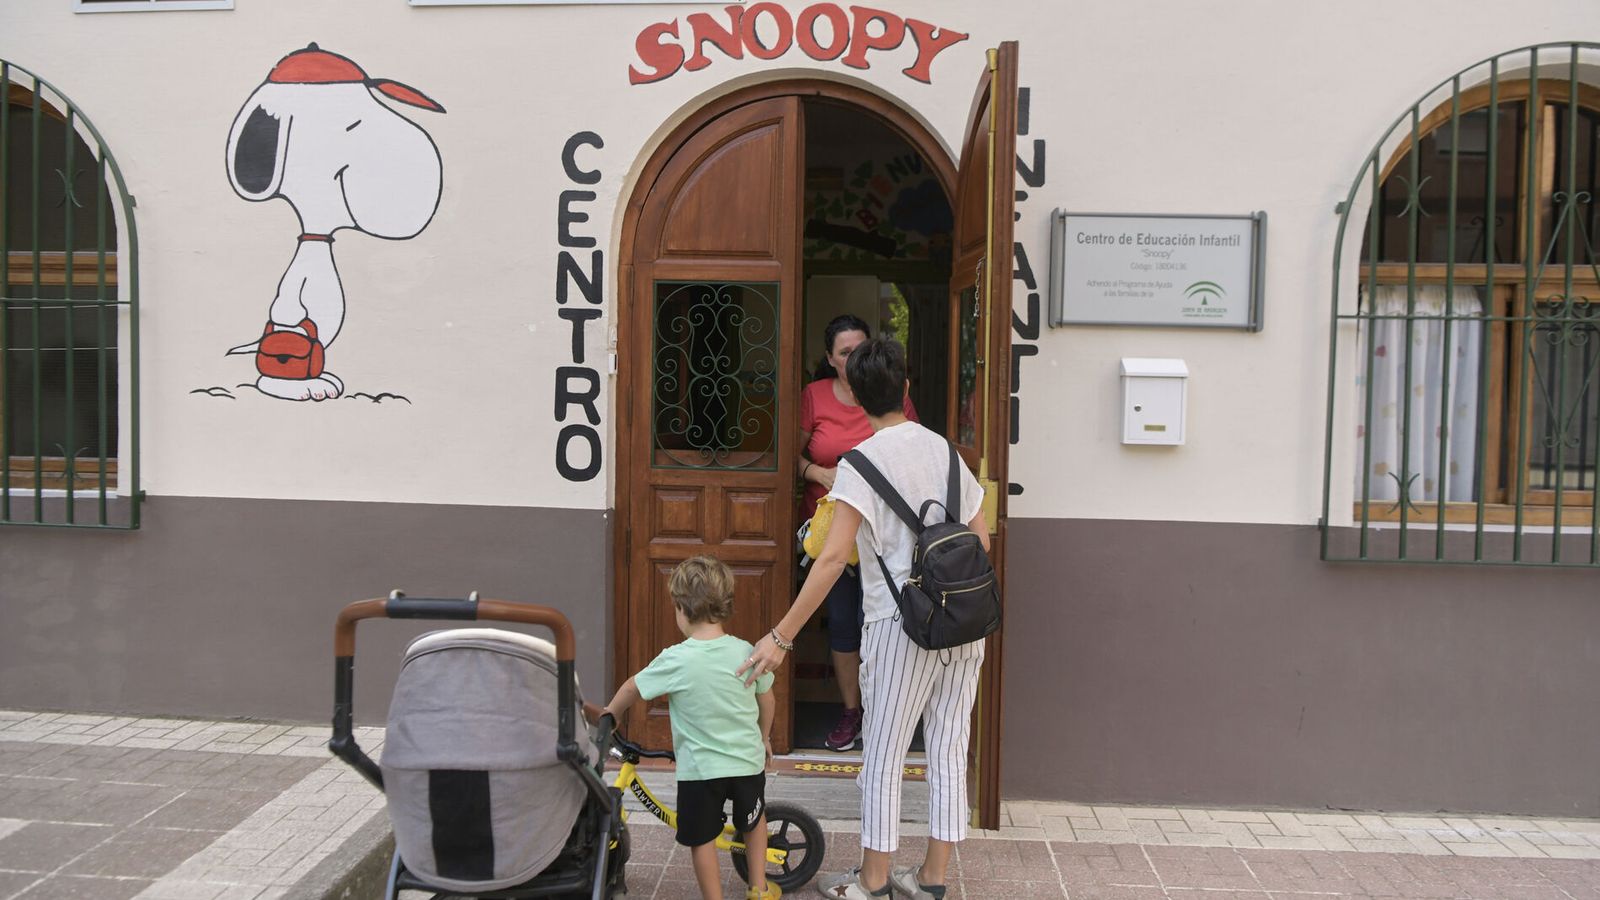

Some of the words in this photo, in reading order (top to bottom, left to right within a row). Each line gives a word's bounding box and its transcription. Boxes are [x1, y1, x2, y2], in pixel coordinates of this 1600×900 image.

[629, 2, 969, 85] SNOOPY
[1077, 232, 1115, 245] Centro
[1118, 233, 1133, 245] de
[1136, 233, 1196, 246] Educación
[1199, 234, 1240, 247] Infantil
[554, 131, 604, 482] CENTRO
[632, 783, 661, 816] SAWYER
